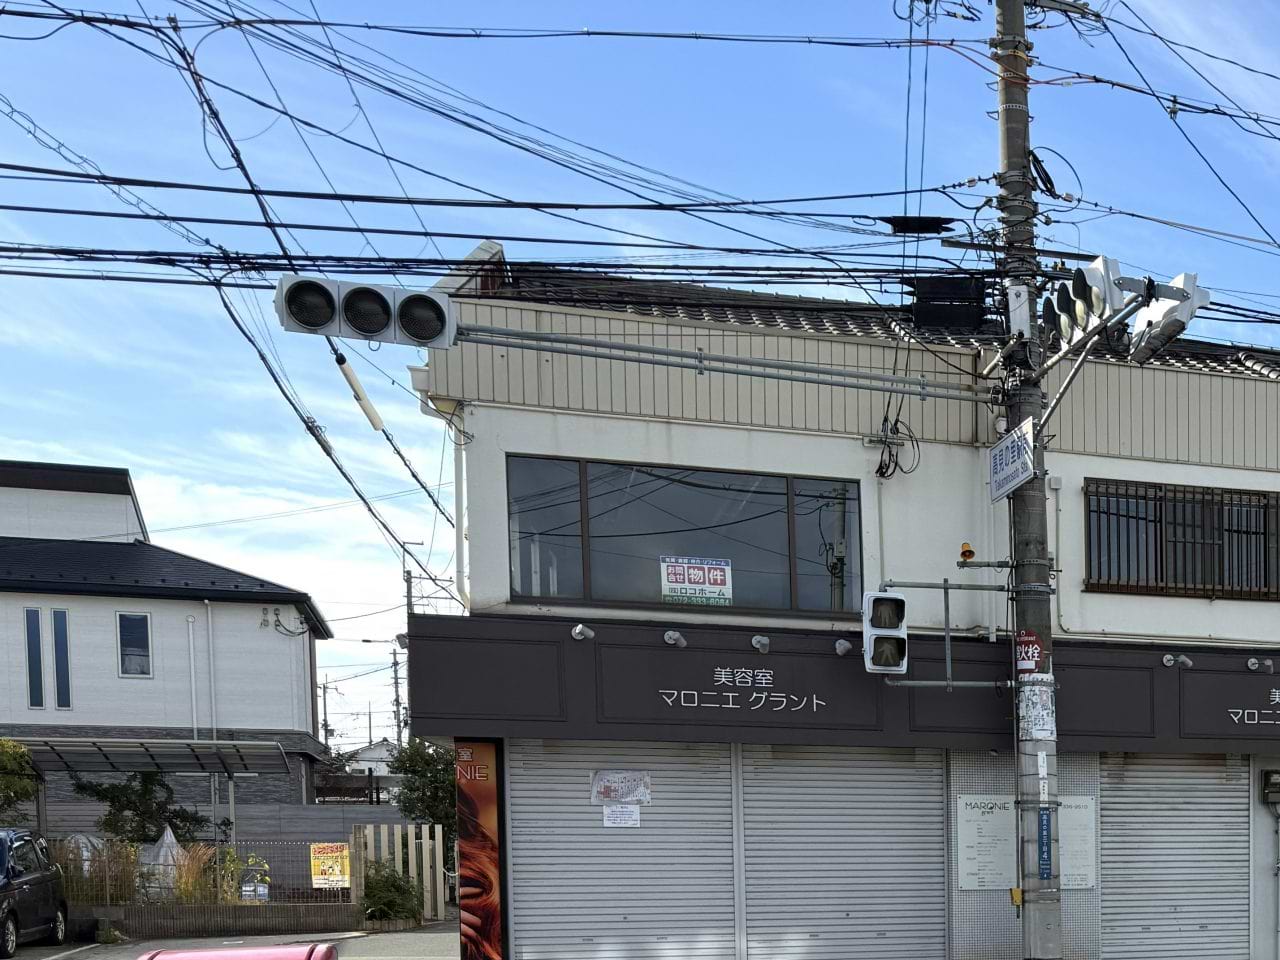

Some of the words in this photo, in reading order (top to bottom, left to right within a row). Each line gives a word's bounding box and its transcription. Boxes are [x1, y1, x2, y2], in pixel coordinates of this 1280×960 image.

[714, 667, 774, 687] 美容室
[659, 690, 741, 708] マロニエ
[749, 692, 826, 711] グラント
